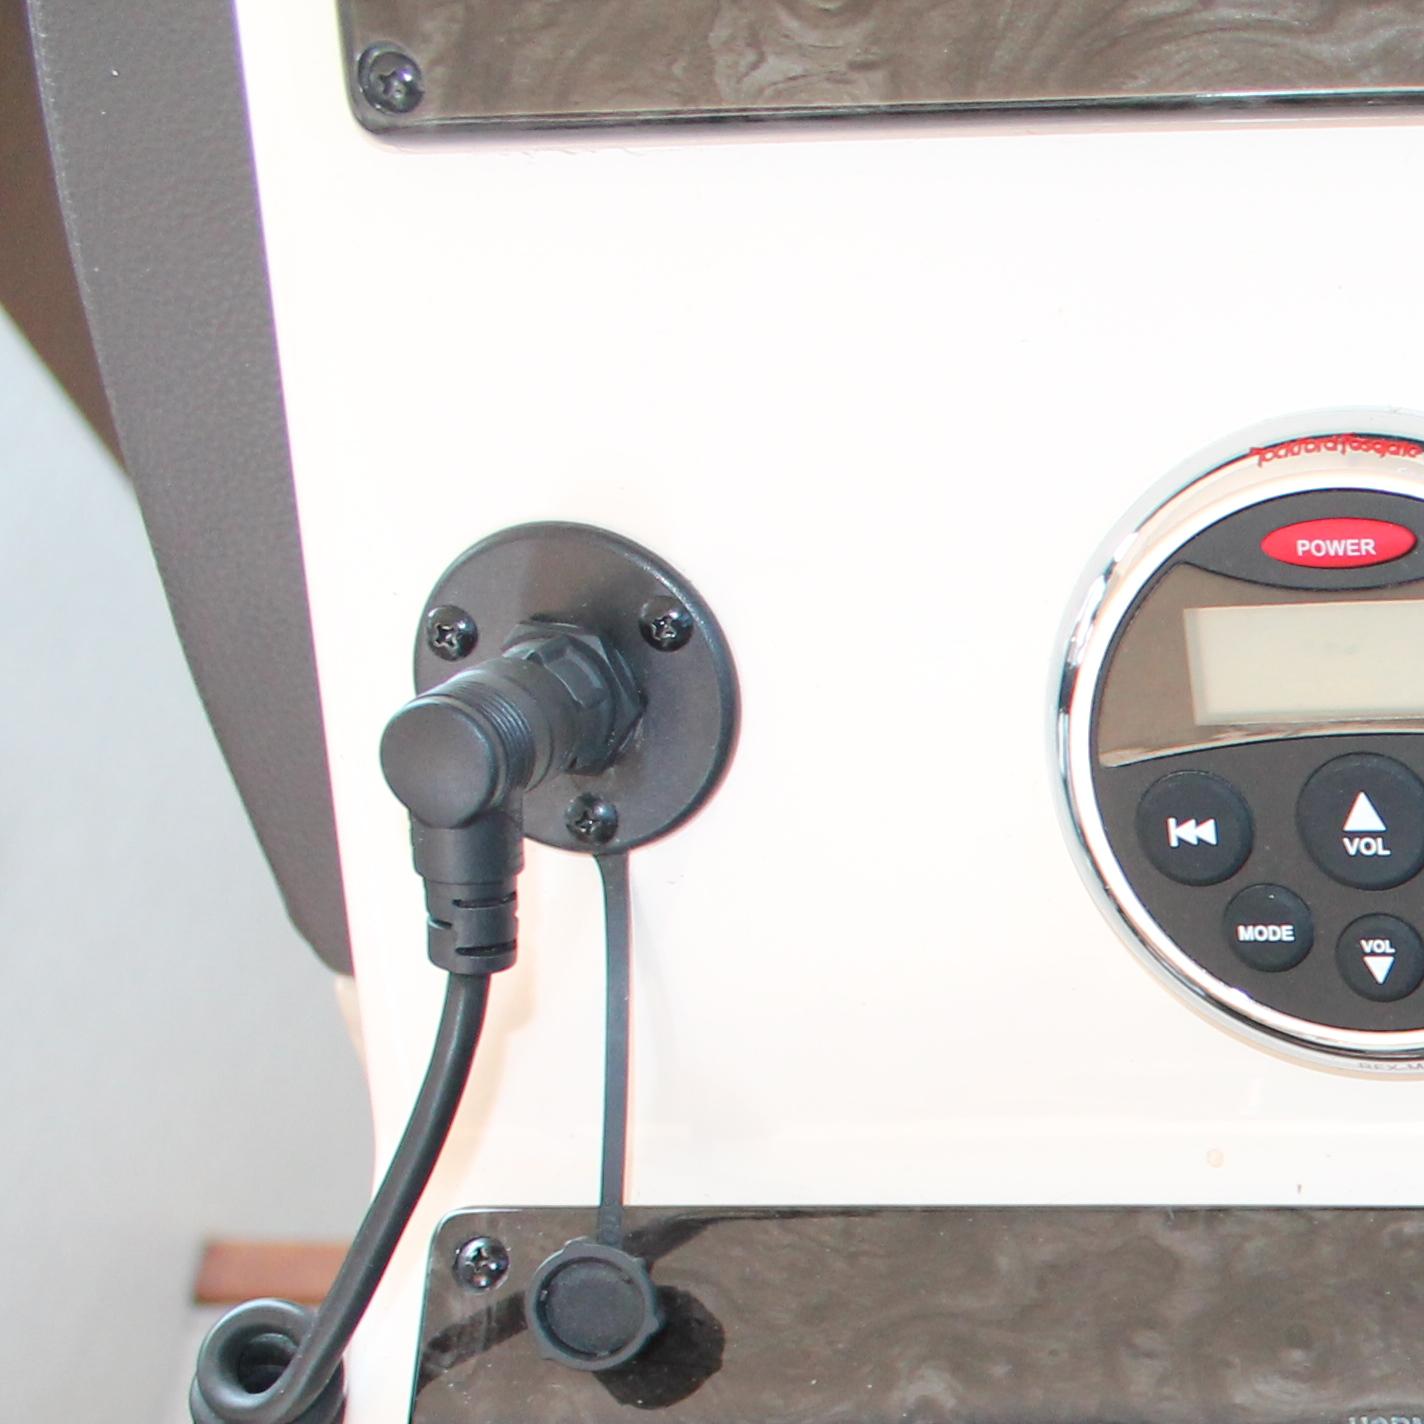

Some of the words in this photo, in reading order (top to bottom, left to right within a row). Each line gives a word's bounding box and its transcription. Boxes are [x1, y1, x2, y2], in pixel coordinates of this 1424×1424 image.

[1296, 538, 1376, 557] POWER
[1343, 838, 1390, 856] VOL
[1238, 925, 1295, 941] MODE
[1361, 939, 1395, 953] VOL
